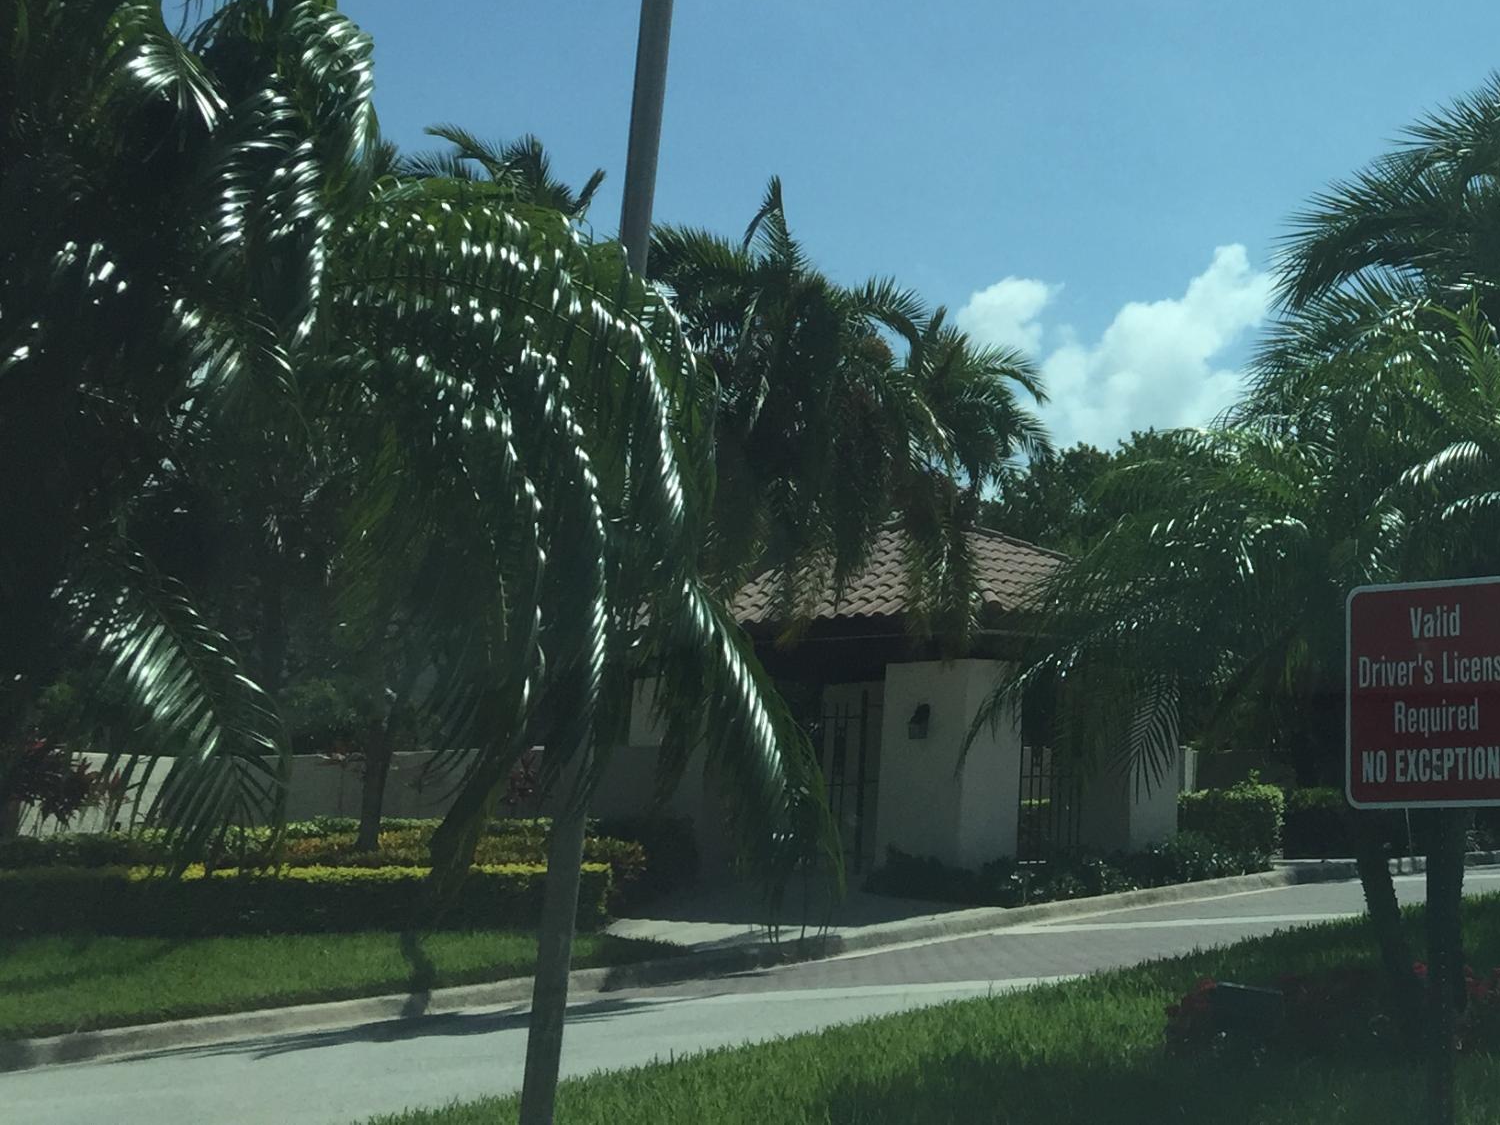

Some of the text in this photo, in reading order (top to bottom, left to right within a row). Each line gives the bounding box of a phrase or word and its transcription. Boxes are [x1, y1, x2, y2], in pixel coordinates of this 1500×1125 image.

[1410, 604, 1460, 638] Valid
[1358, 652, 1434, 688] Driver's
[1394, 697, 1479, 738] Required
[1362, 749, 1387, 783] NO
